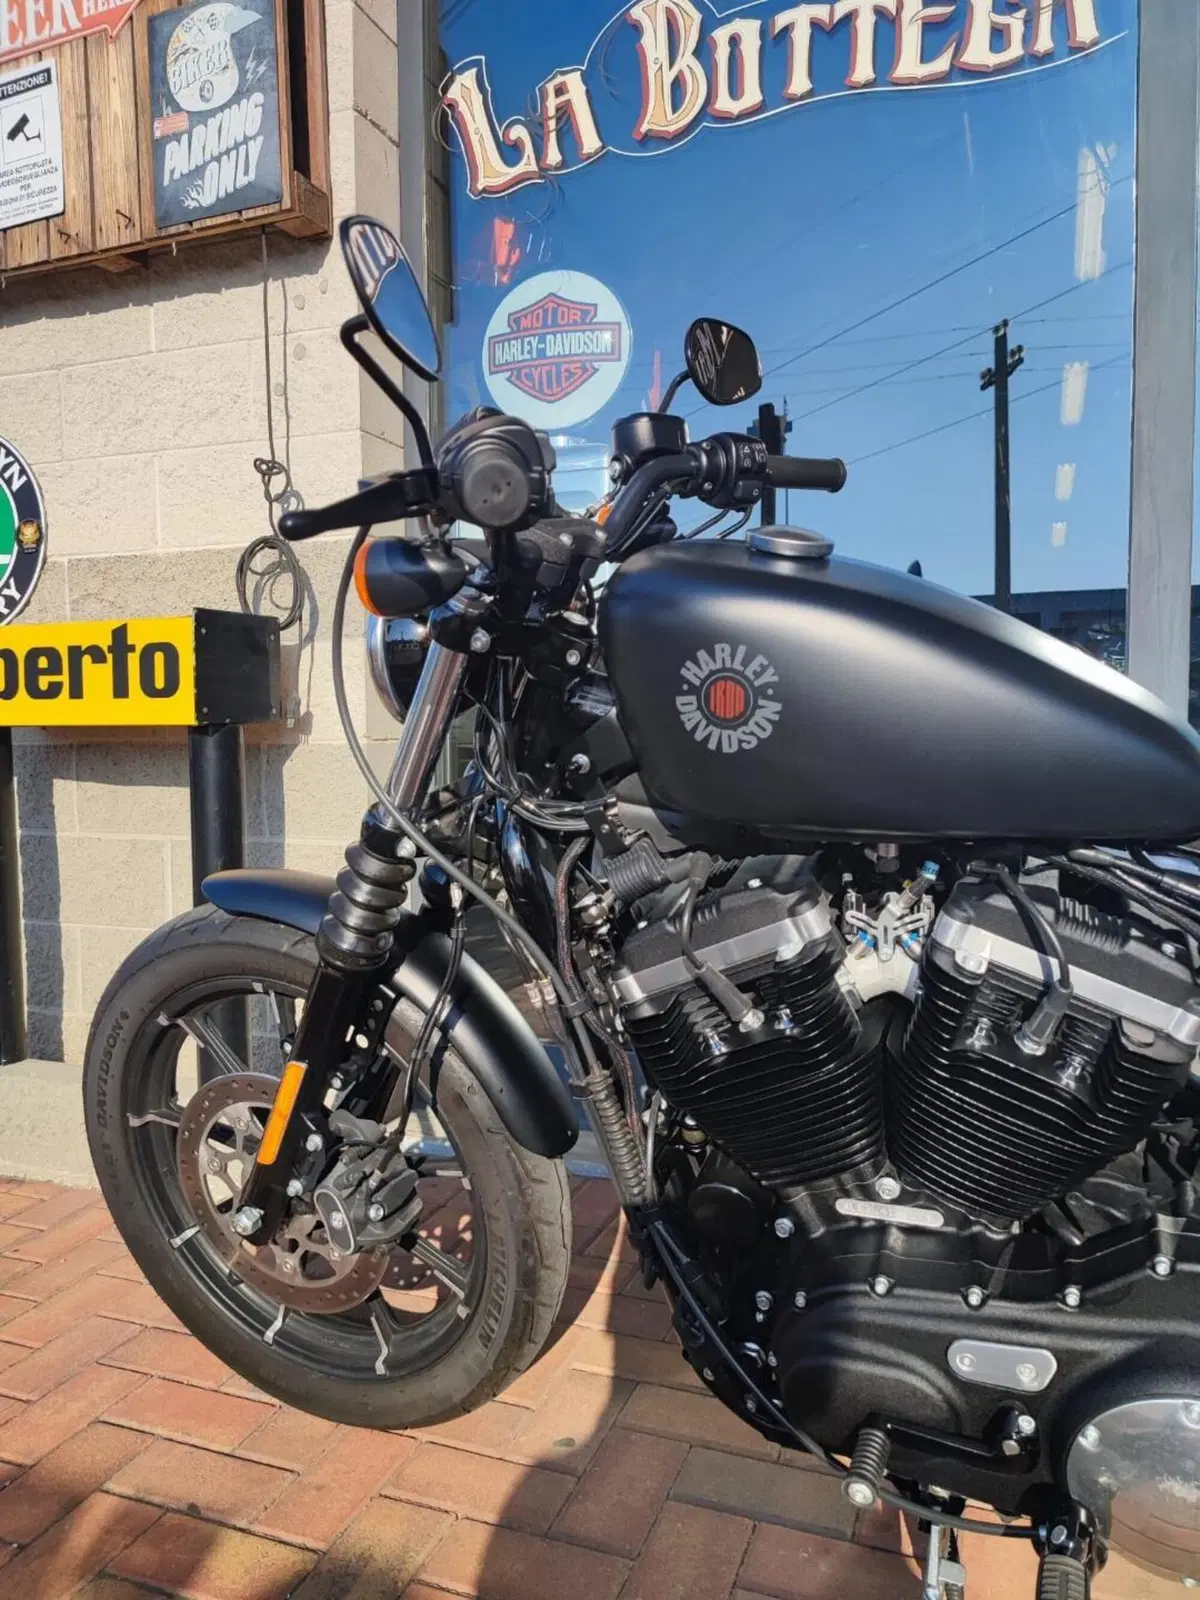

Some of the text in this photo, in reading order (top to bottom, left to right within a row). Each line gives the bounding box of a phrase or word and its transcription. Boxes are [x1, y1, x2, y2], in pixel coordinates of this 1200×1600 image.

[171, 38, 231, 96] BIKER
[163, 91, 265, 188] PARKING
[443, 65, 603, 195] LA
[199, 135, 264, 208] ONLY
[519, 300, 583, 331] MOTOR
[494, 329, 613, 366] HARLEY-DAVIDSON
[519, 361, 583, 395] CYCLES
[680, 642, 780, 688] HARLEY
[675, 694, 783, 754] DAVIDSON
